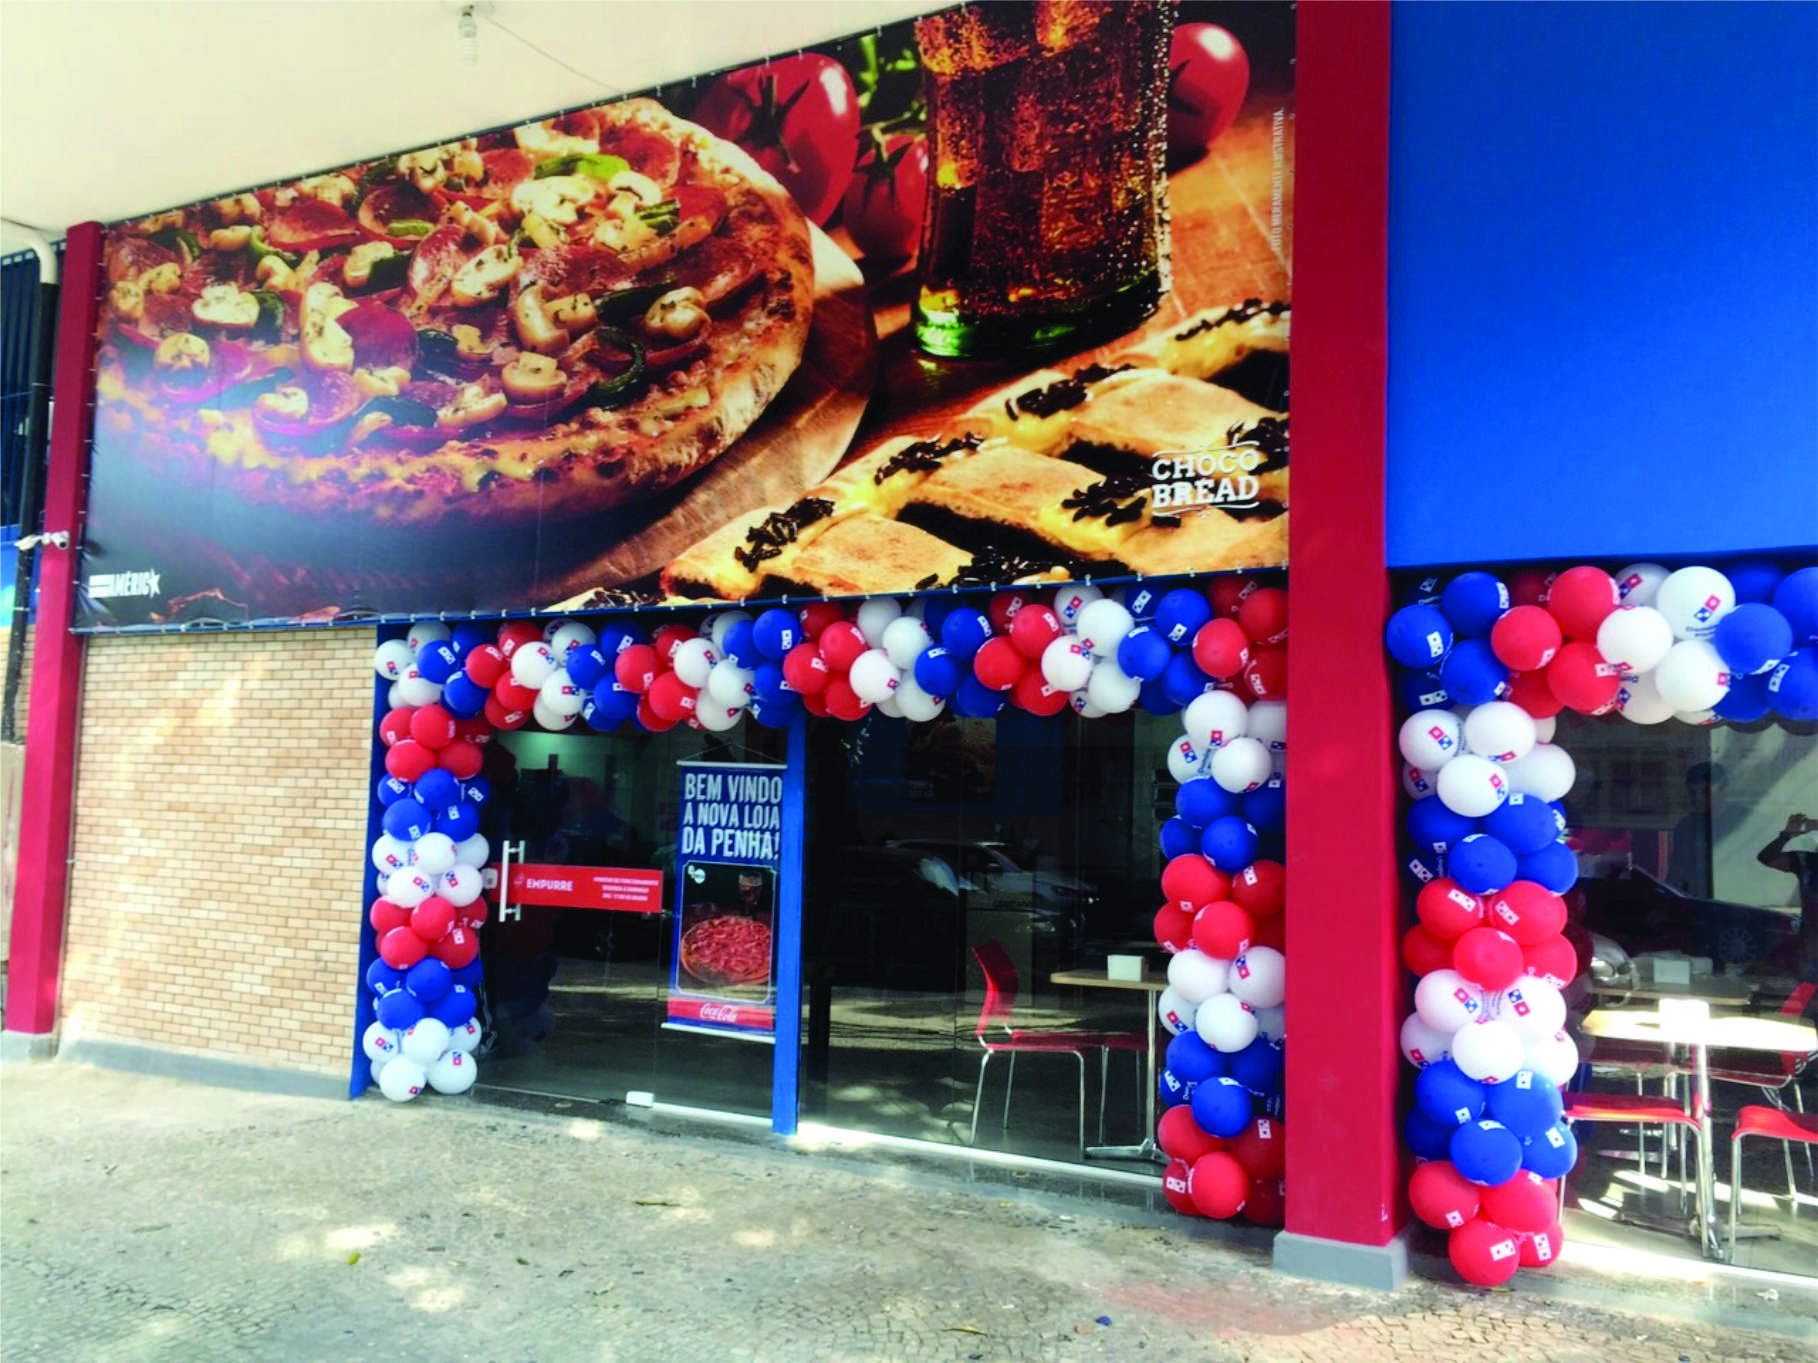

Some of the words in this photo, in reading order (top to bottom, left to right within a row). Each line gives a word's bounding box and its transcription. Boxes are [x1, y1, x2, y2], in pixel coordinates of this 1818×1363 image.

[1152, 449, 1260, 481] CHOCO
[1152, 475, 1260, 509] BREAD
[685, 773, 722, 801] BEM
[727, 774, 783, 804] VINDO
[683, 801, 694, 825] A
[697, 802, 739, 828] NOVA
[743, 804, 780, 830] LOJA
[681, 826, 706, 855] DA
[711, 828, 780, 861] PENHA!
[526, 878, 574, 892] EMPURRE
